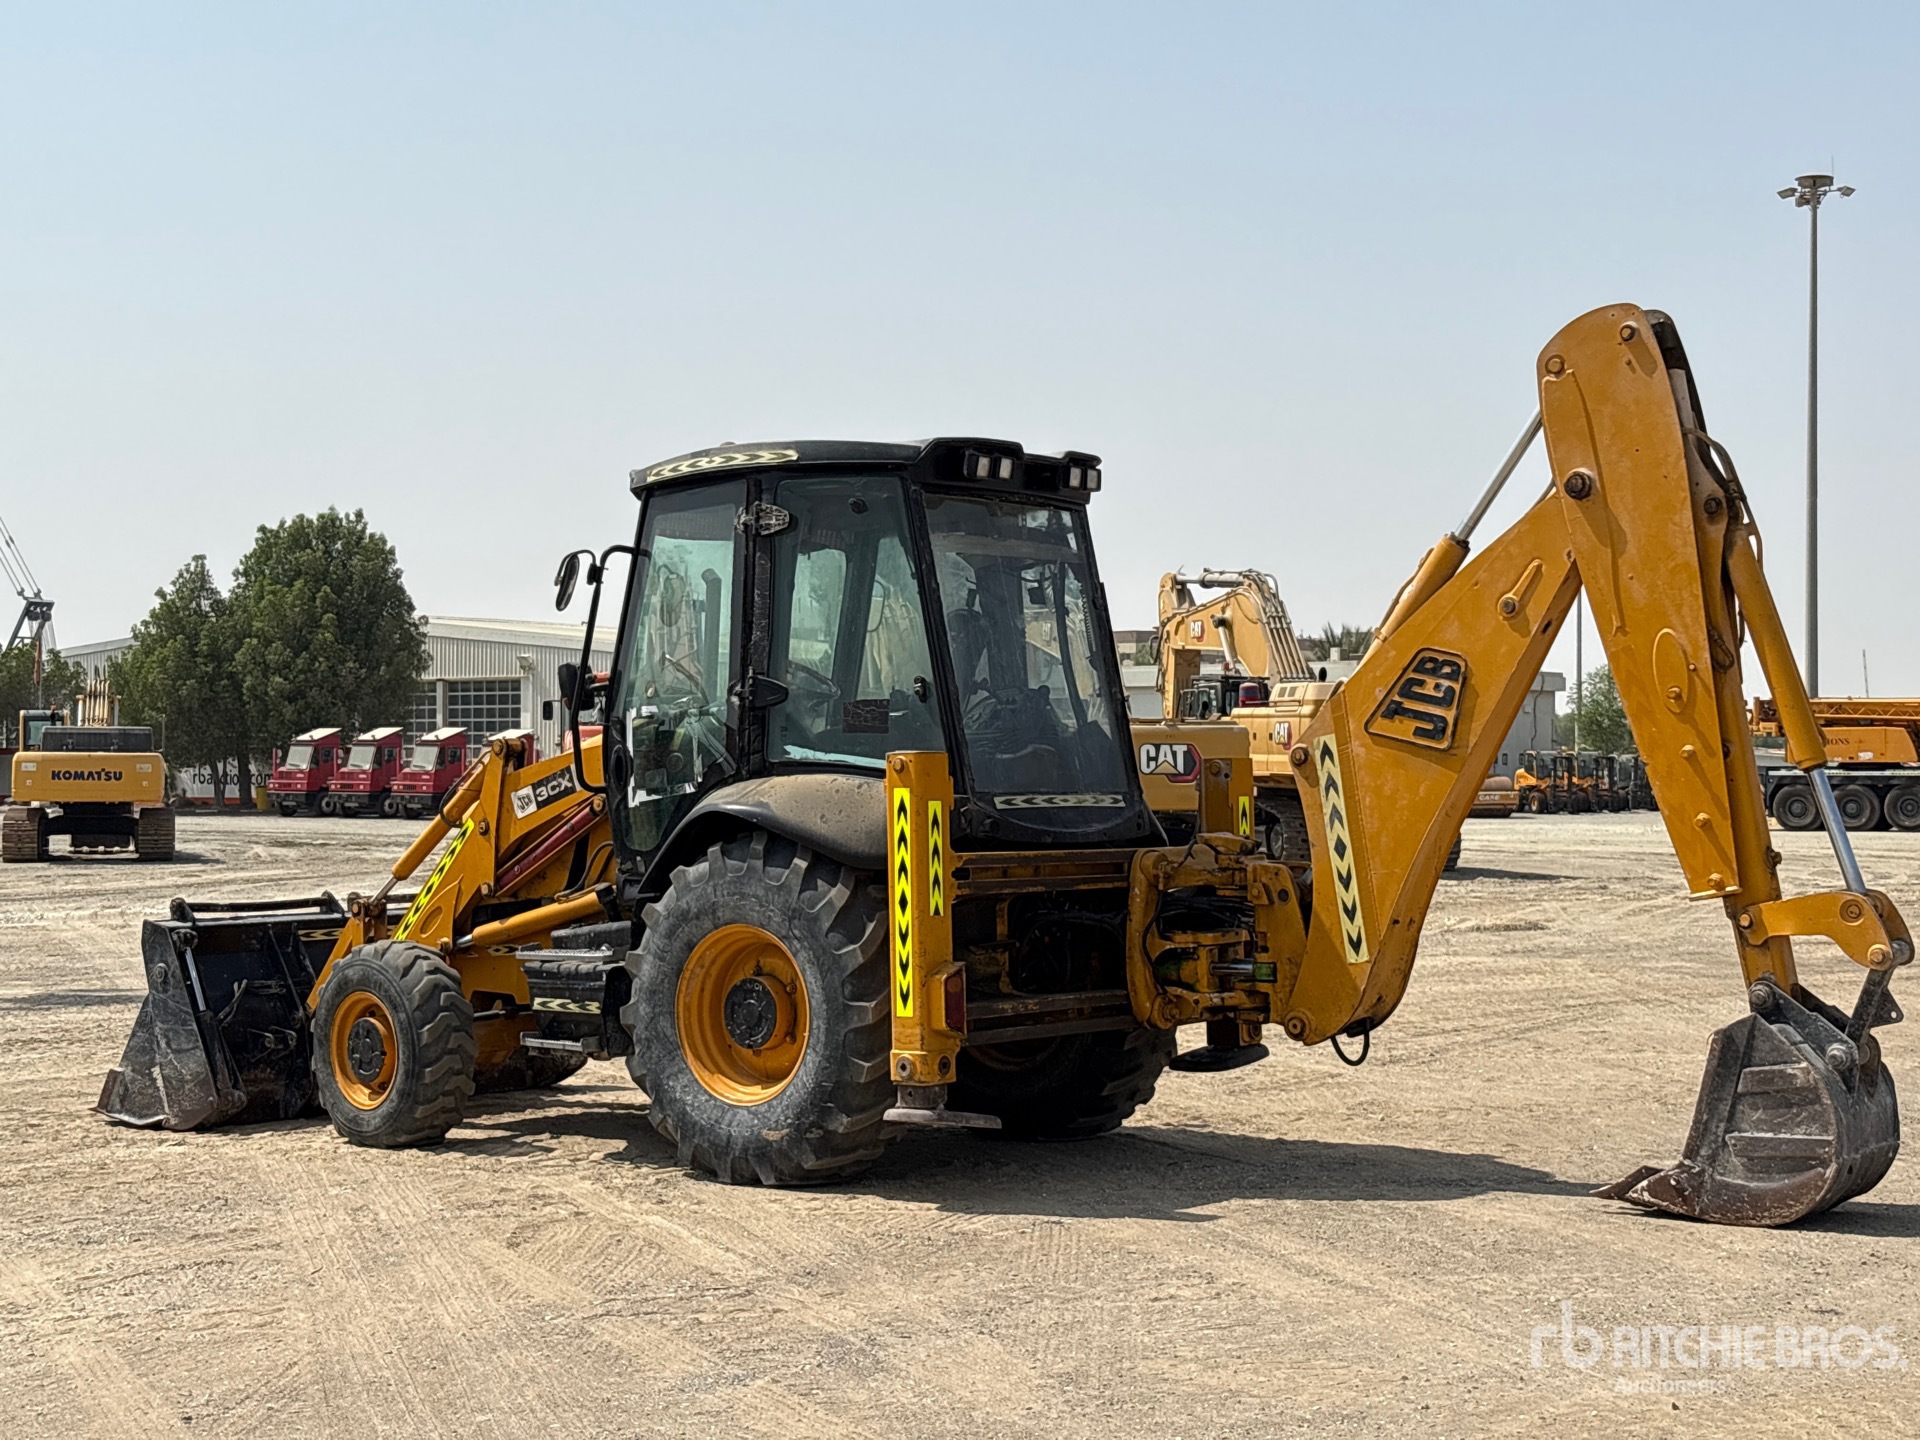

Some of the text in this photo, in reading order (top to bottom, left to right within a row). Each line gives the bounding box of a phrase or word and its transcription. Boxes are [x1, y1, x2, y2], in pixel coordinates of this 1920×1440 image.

[1190, 621, 1202, 638] CAT
[1381, 656, 1462, 741] JCB
[1275, 722, 1290, 744] CAT
[1827, 737, 1850, 746] IONS
[1140, 744, 1188, 775] CAT
[52, 767, 123, 781] KOMATSU
[517, 774, 573, 811] JCB 3CX
